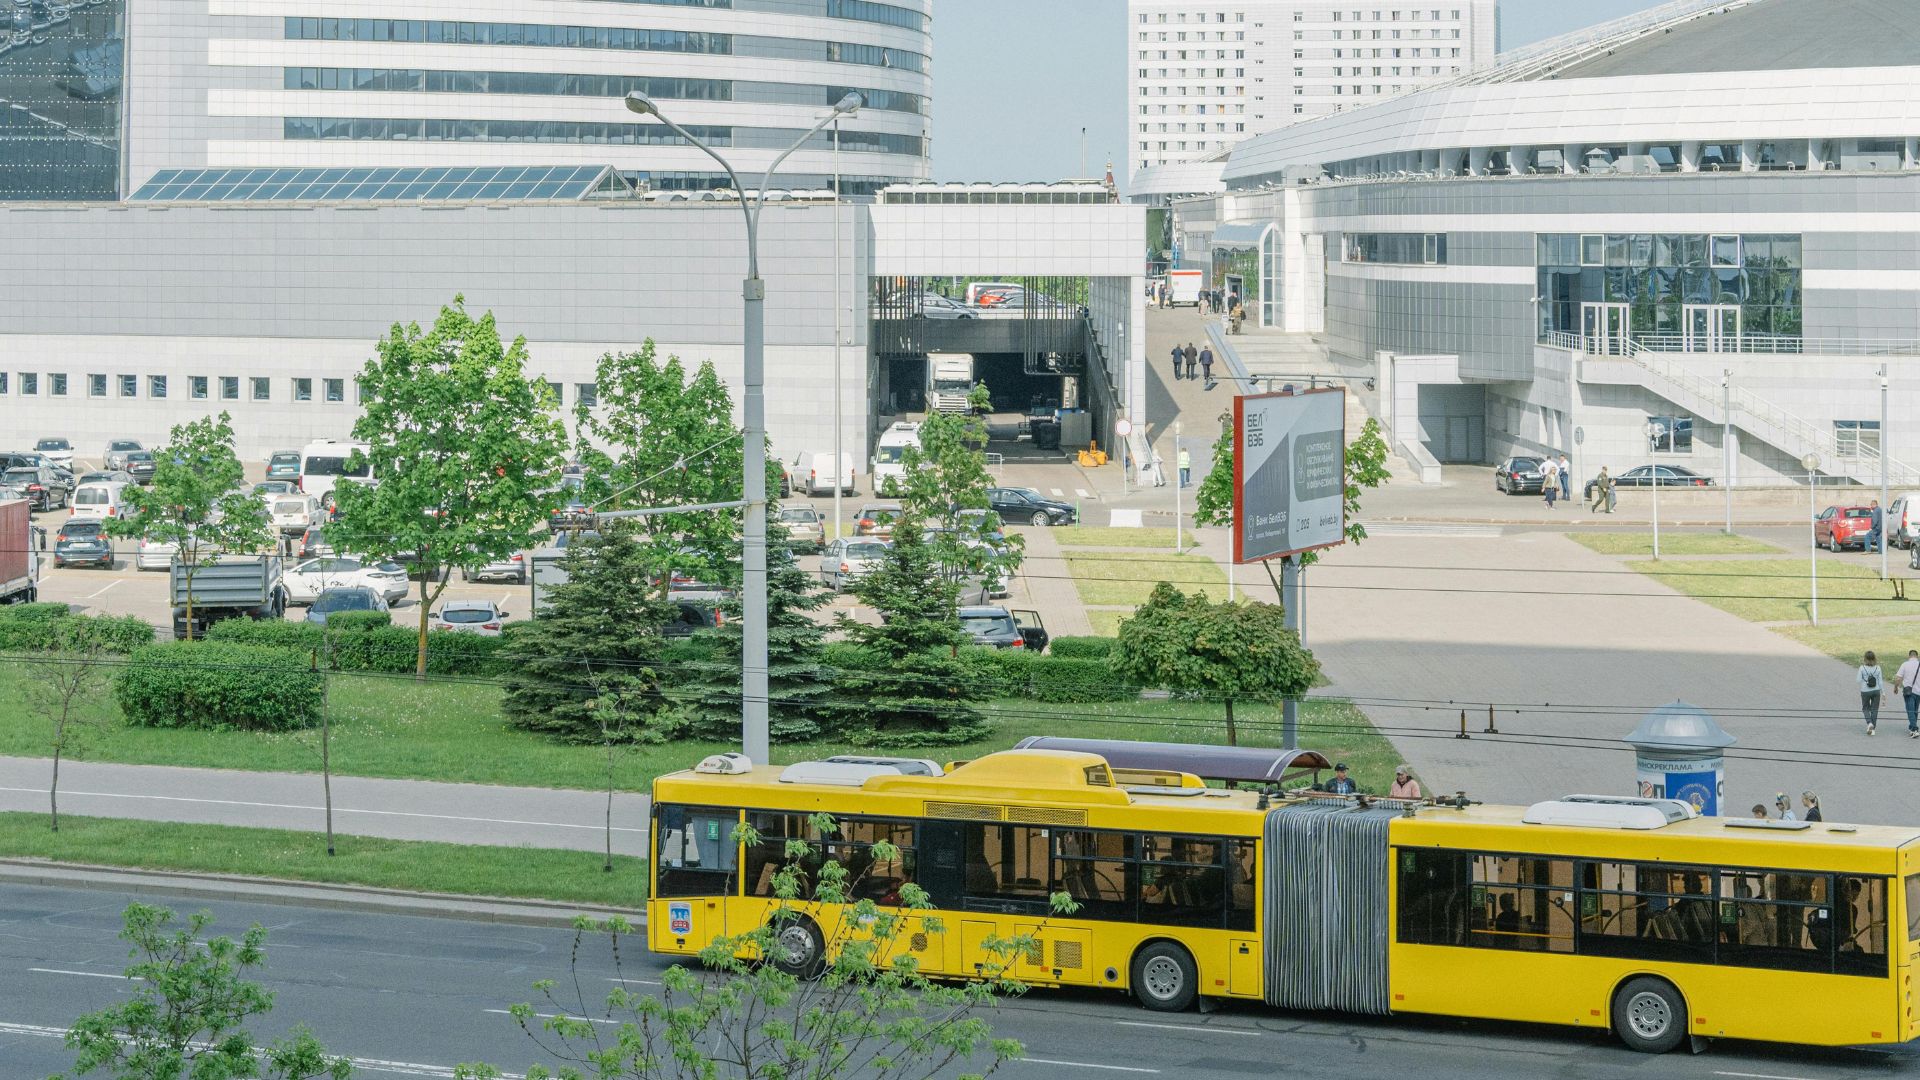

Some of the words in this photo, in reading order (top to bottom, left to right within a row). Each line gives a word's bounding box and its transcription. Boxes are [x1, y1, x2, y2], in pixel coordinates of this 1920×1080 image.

[1248, 413, 1263, 427] БЕЛ
[1248, 433, 1264, 447] ВЭБ
[1256, 515, 1268, 526] Банк
